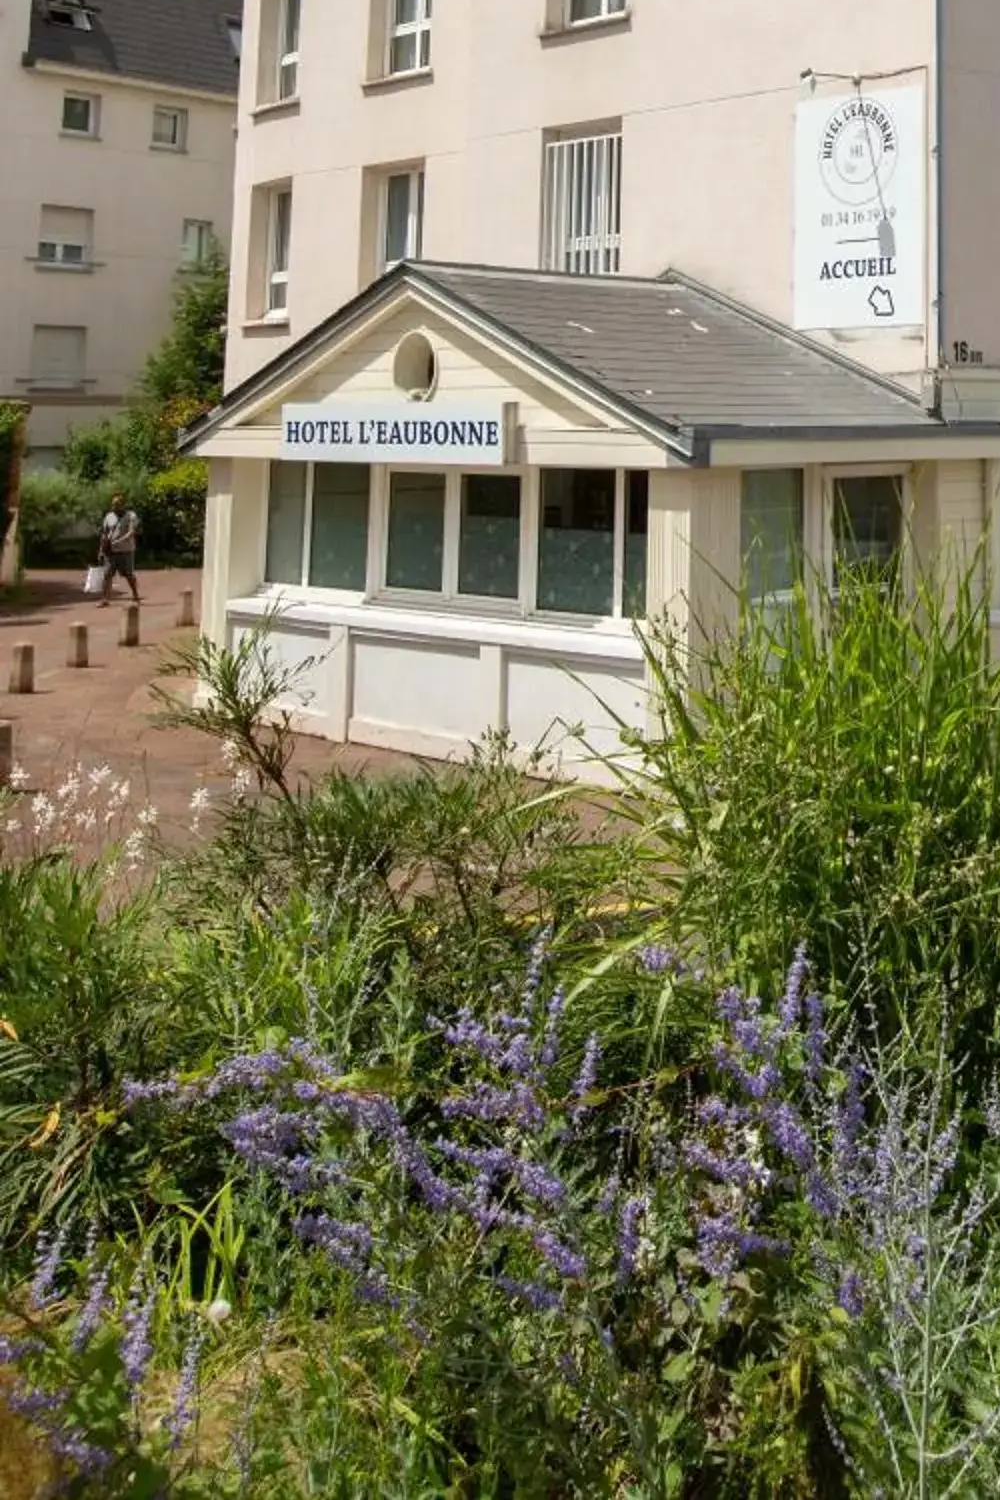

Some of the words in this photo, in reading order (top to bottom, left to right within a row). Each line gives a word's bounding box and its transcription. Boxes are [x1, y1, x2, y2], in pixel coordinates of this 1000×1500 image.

[823, 116, 843, 160] HOTEL
[819, 256, 897, 281] ACCUEIL
[285, 420, 353, 445] HOTEL
[358, 419, 499, 446] L'EAUBONNE
